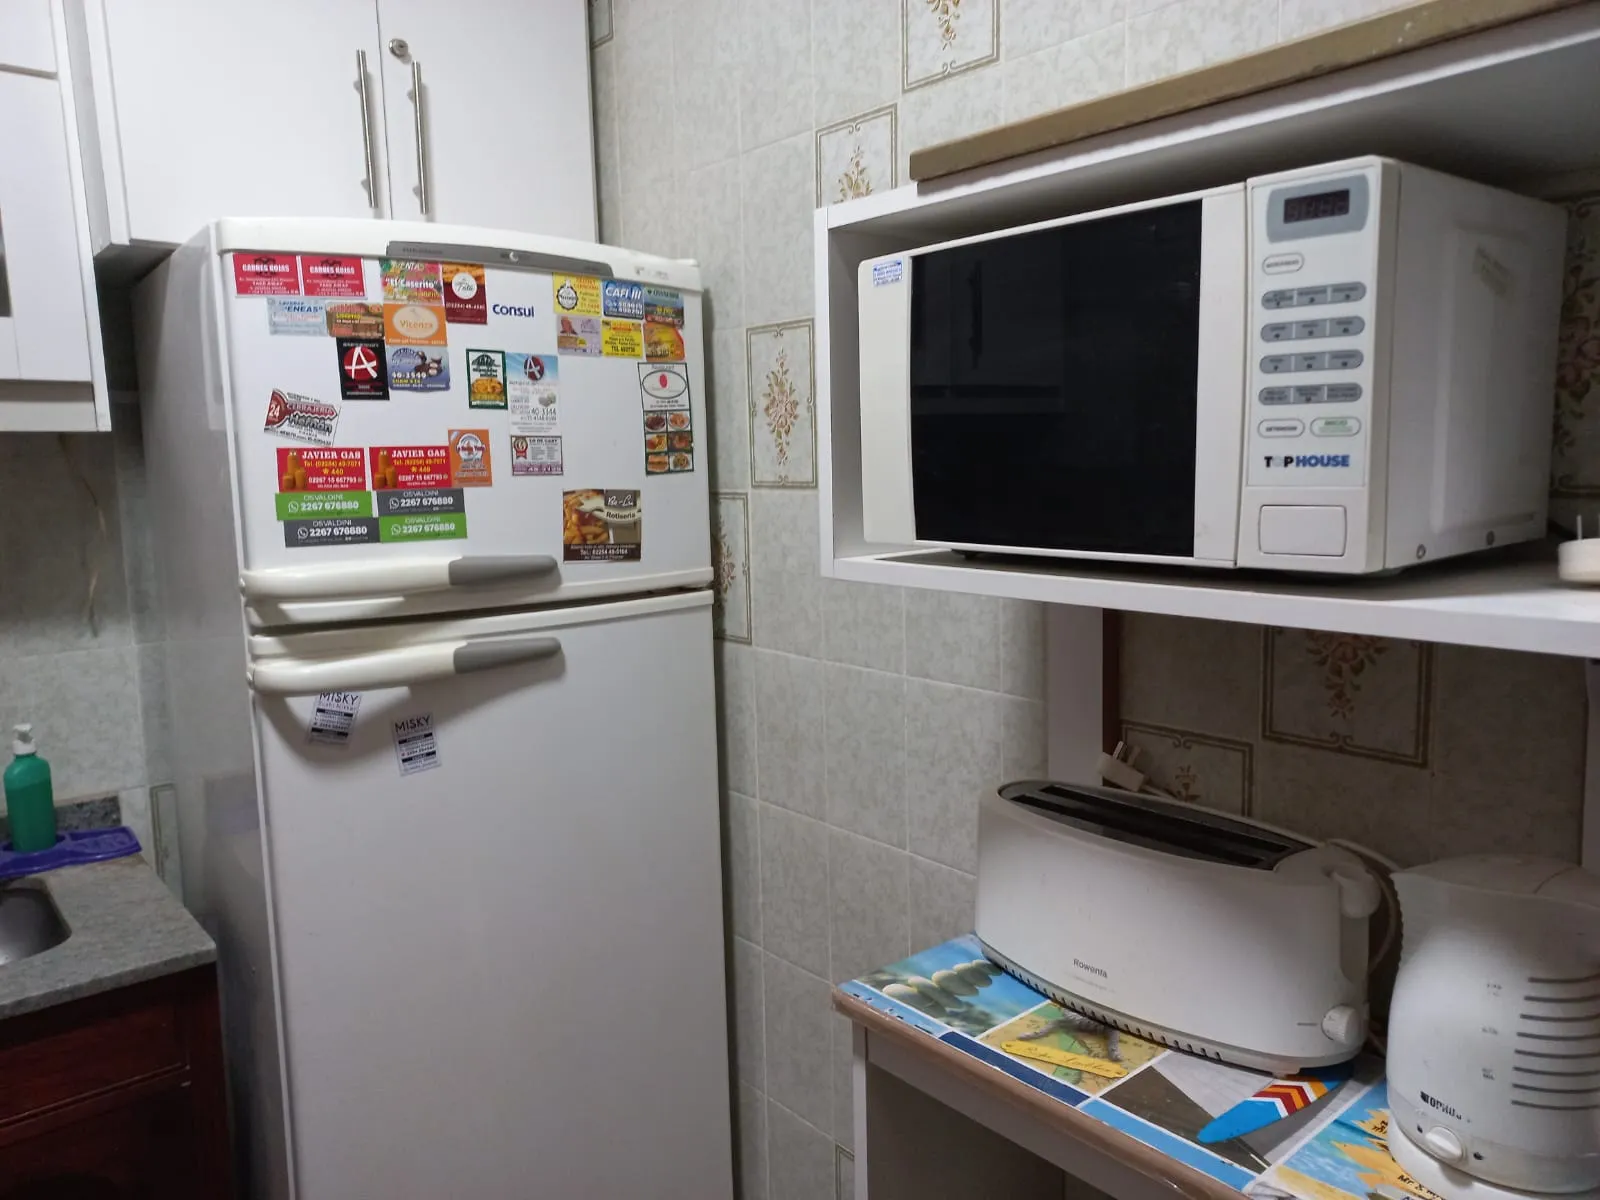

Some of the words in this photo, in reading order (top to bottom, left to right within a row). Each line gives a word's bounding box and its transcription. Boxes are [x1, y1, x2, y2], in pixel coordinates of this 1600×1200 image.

[492, 303, 535, 317] Consul
[268, 404, 280, 417] 24
[301, 450, 338, 460] JAVIER
[341, 450, 361, 460] GAS
[391, 449, 424, 459] JAVIER
[427, 449, 446, 458] GAS
[403, 490, 439, 498] OSVALDINI
[300, 502, 322, 511] 2267
[400, 498, 420, 507] 2267
[312, 520, 352, 528] OSVALDINI
[402, 525, 422, 533] 2267
[309, 528, 331, 537] 2267
[319, 691, 359, 706] MISKY
[394, 714, 431, 734] MISKY
[1073, 957, 1108, 979] Rowenta
